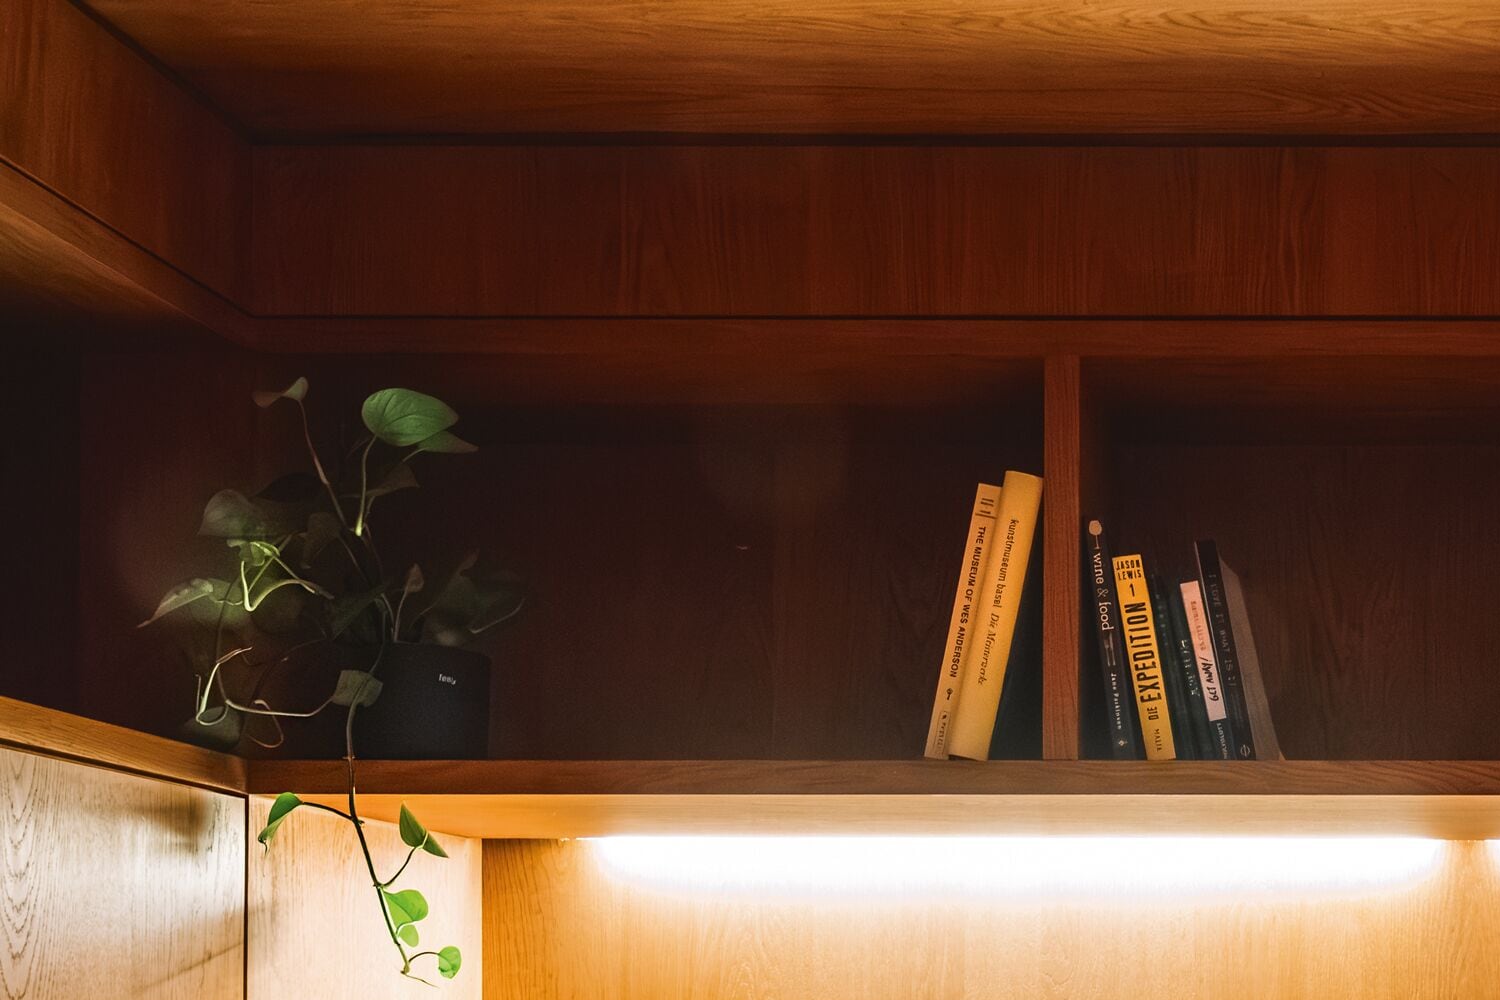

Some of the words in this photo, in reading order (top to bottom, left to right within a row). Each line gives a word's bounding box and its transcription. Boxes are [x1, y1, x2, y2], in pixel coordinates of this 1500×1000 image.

[976, 526, 986, 544] THE
[998, 519, 1020, 582] kunstmuseum
[967, 546, 982, 586] MUSEUM
[1093, 552, 1104, 585] wine
[1115, 559, 1140, 569] JASON
[1118, 569, 1142, 580] LEWIS
[964, 589, 974, 602] OF
[992, 584, 1006, 608] basel
[1097, 588, 1109, 598] &
[1129, 583, 1135, 597] 1
[960, 604, 970, 624] WES
[989, 613, 1000, 628] Die
[1098, 601, 1115, 631] food
[949, 626, 966, 678] ANDERSON
[1123, 602, 1162, 703] EXPEDITION
[1146, 706, 1160, 721] DIE
